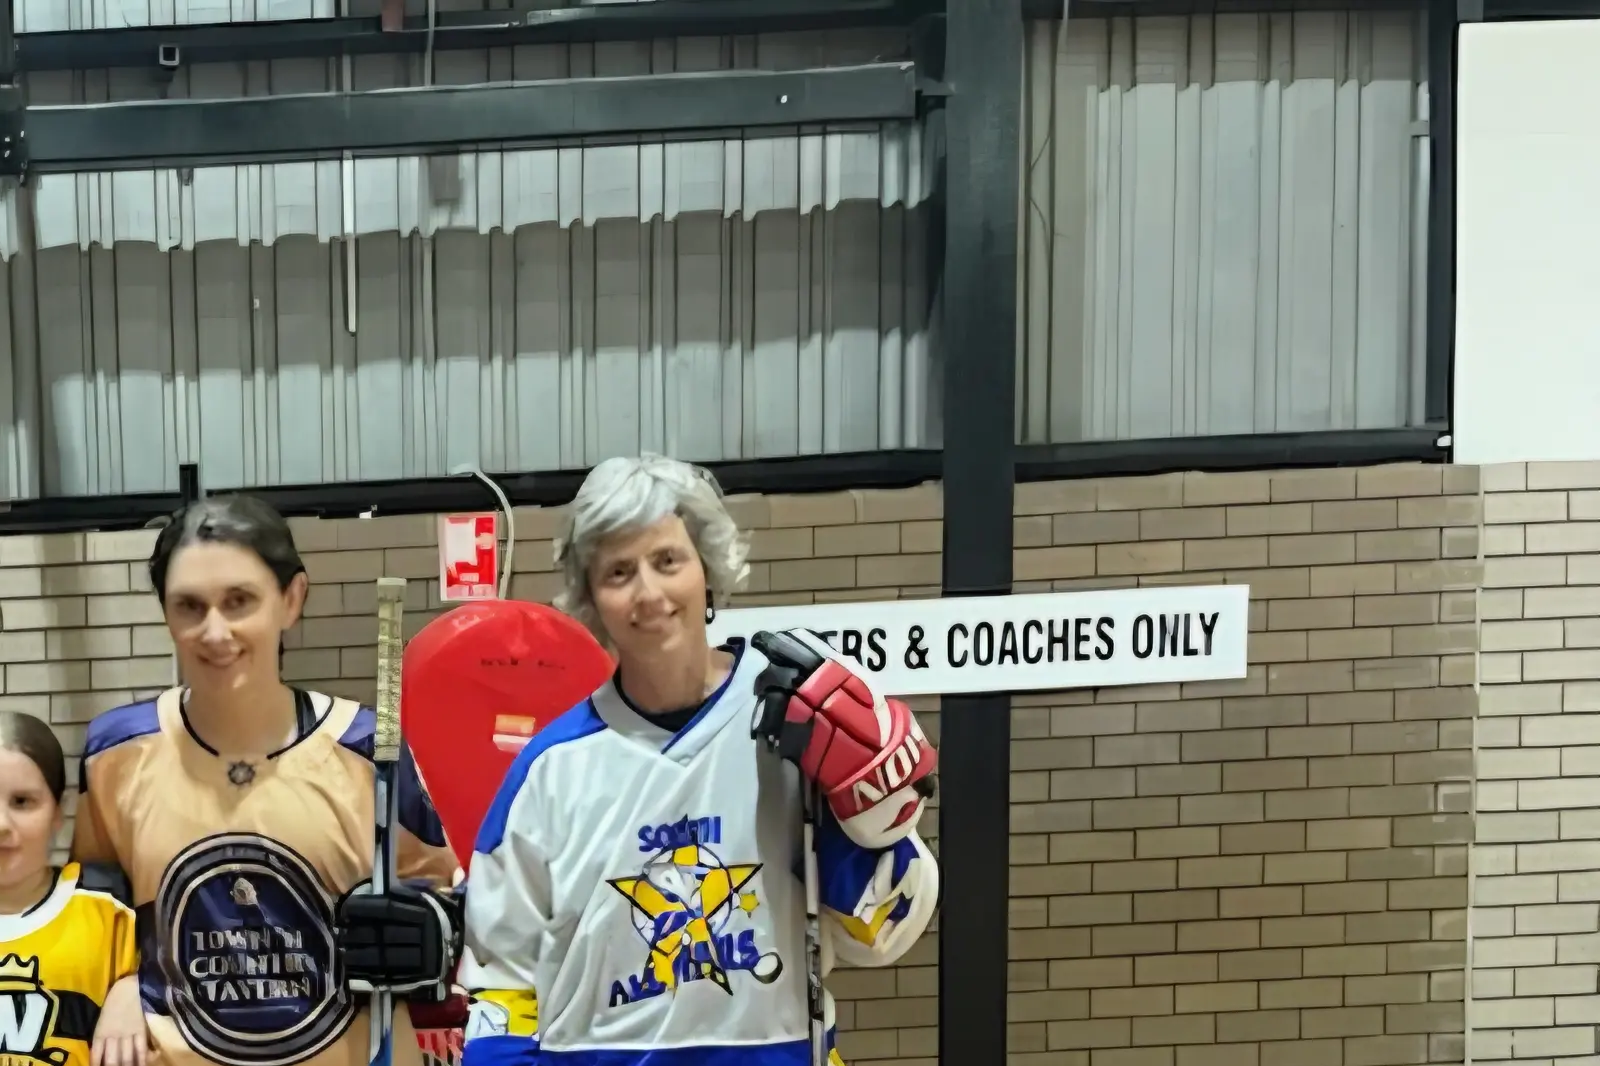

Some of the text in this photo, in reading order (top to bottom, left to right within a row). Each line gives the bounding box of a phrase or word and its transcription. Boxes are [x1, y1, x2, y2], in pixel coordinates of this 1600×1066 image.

[904, 624, 930, 669] &
[947, 616, 1115, 668] COACHES
[1132, 611, 1220, 659] ONLY
